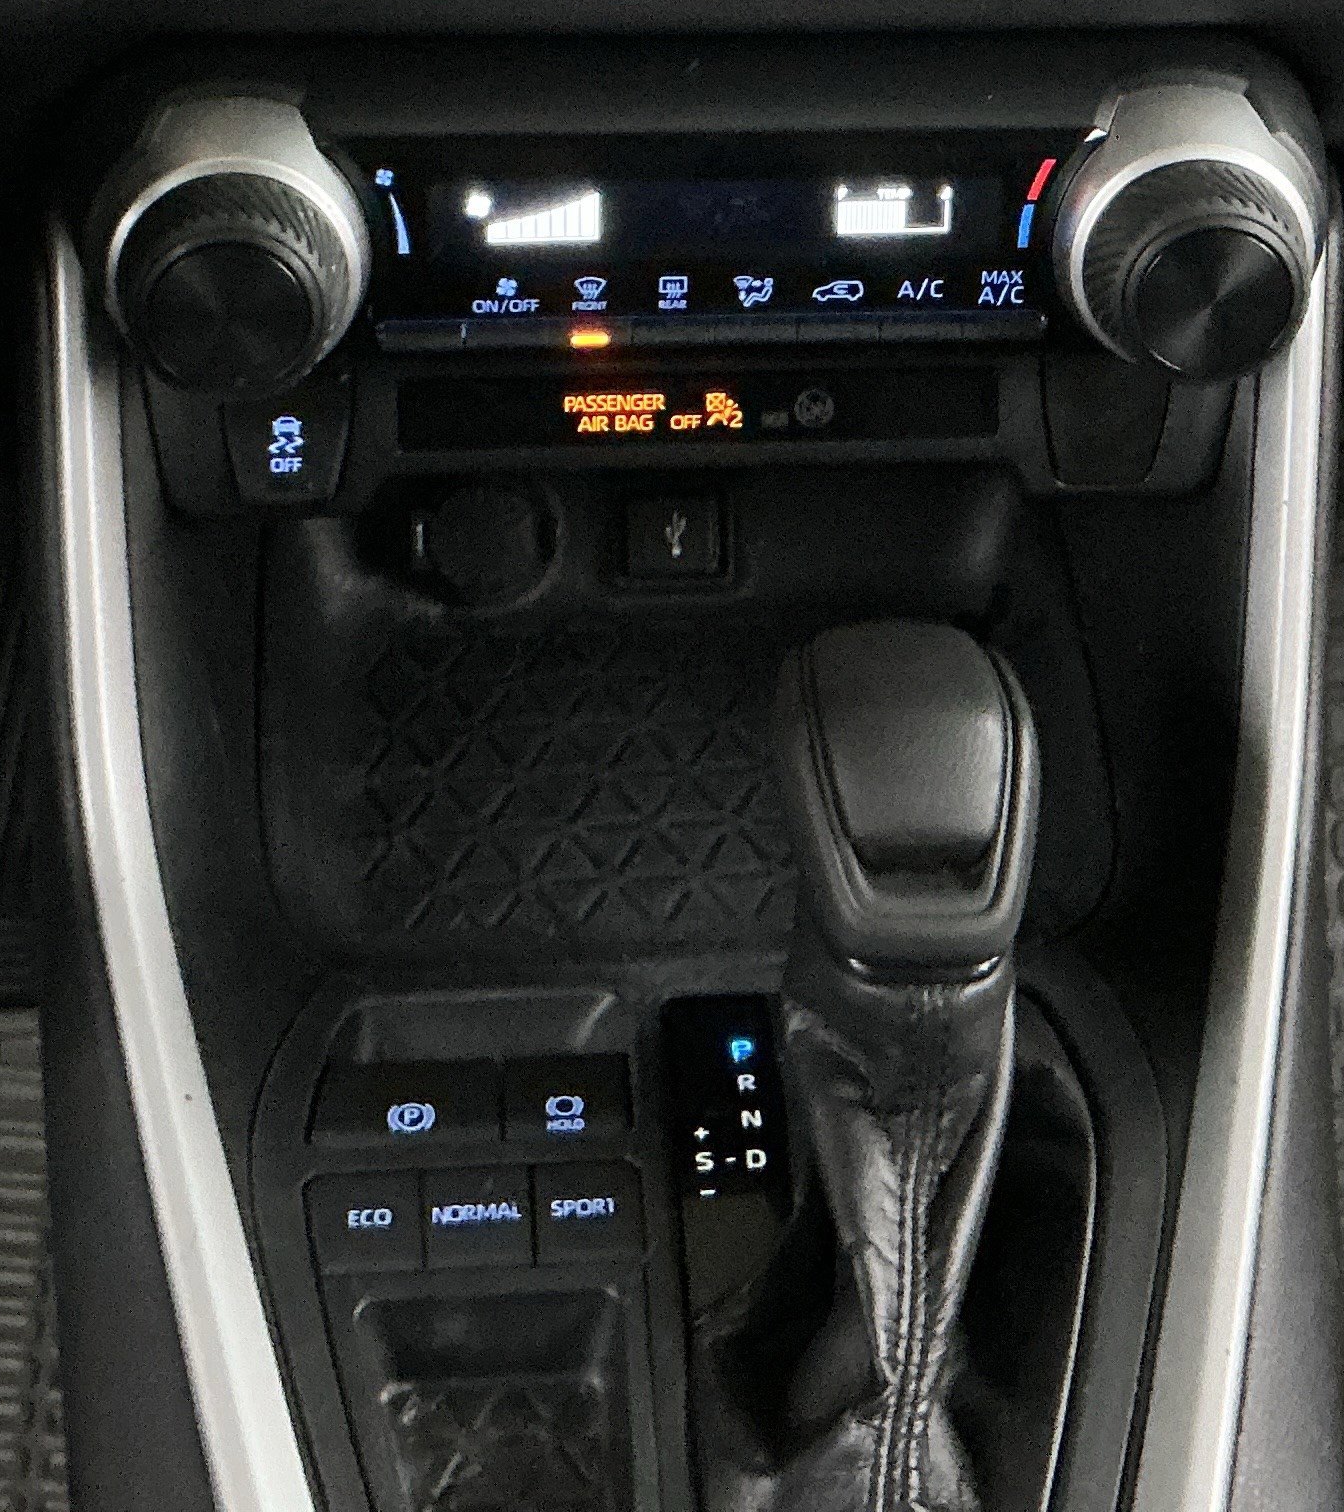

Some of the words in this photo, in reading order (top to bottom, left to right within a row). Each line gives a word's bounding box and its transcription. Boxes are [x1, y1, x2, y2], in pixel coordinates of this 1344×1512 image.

[981, 270, 1024, 284] MAX
[896, 278, 944, 301] A/C
[977, 285, 1025, 306] A/C
[472, 299, 540, 314] ON/OFF
[571, 301, 608, 311] FRONT
[658, 299, 688, 310] REAR
[564, 394, 666, 413] PASSENGER
[577, 416, 609, 432] AIR
[614, 414, 655, 432] BAG
[670, 414, 703, 430] OFF
[270, 457, 303, 473] OFF
[731, 1039, 753, 1063] P
[737, 1073, 756, 1094] R
[741, 1109, 763, 1129] N
[694, 1151, 715, 1172] S
[746, 1148, 767, 1170] D
[347, 1208, 393, 1229] ECO
[431, 1202, 522, 1226] NORMAL
